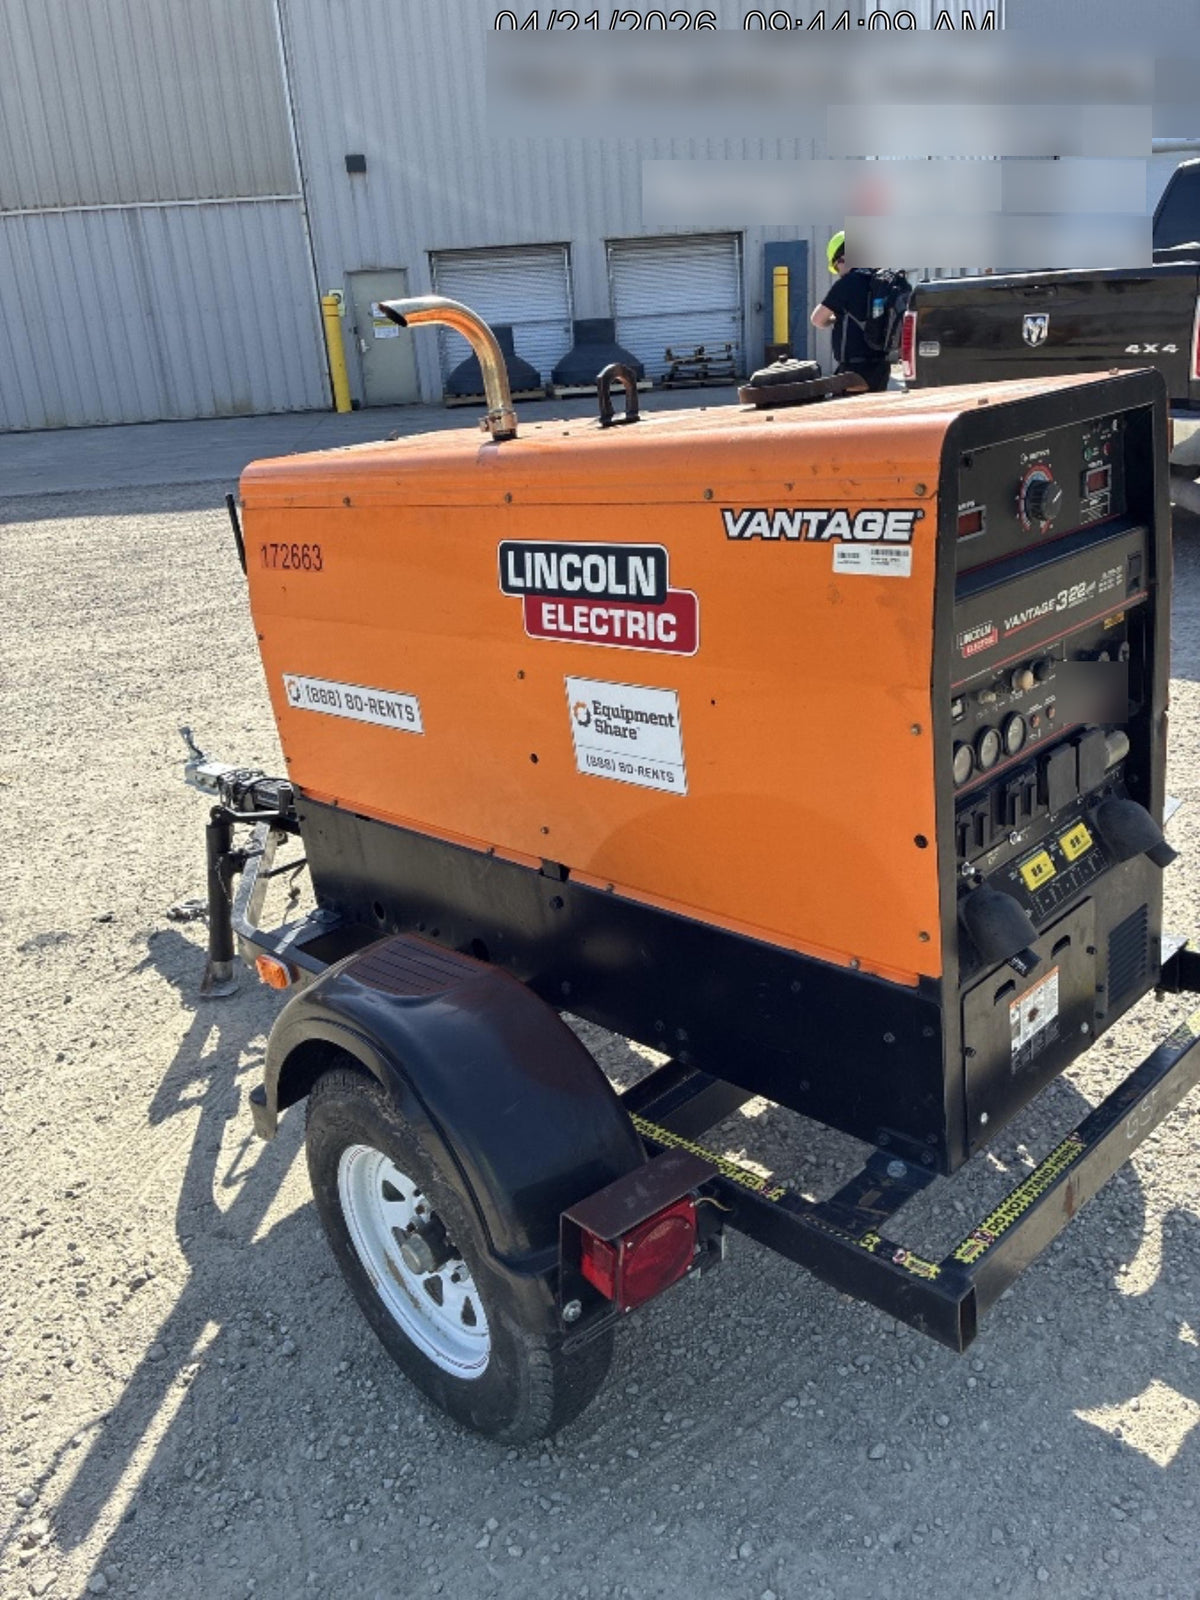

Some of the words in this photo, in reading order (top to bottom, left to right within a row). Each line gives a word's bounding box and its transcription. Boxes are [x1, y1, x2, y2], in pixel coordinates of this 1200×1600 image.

[260, 543, 323, 571] 172663
[507, 550, 657, 597] LINCOLN
[541, 602, 678, 643] ELECTRIC
[305, 684, 343, 709] (888)
[592, 700, 676, 728] Equipment
[595, 718, 638, 740] Share
[987, 1215, 1006, 1232] DO
